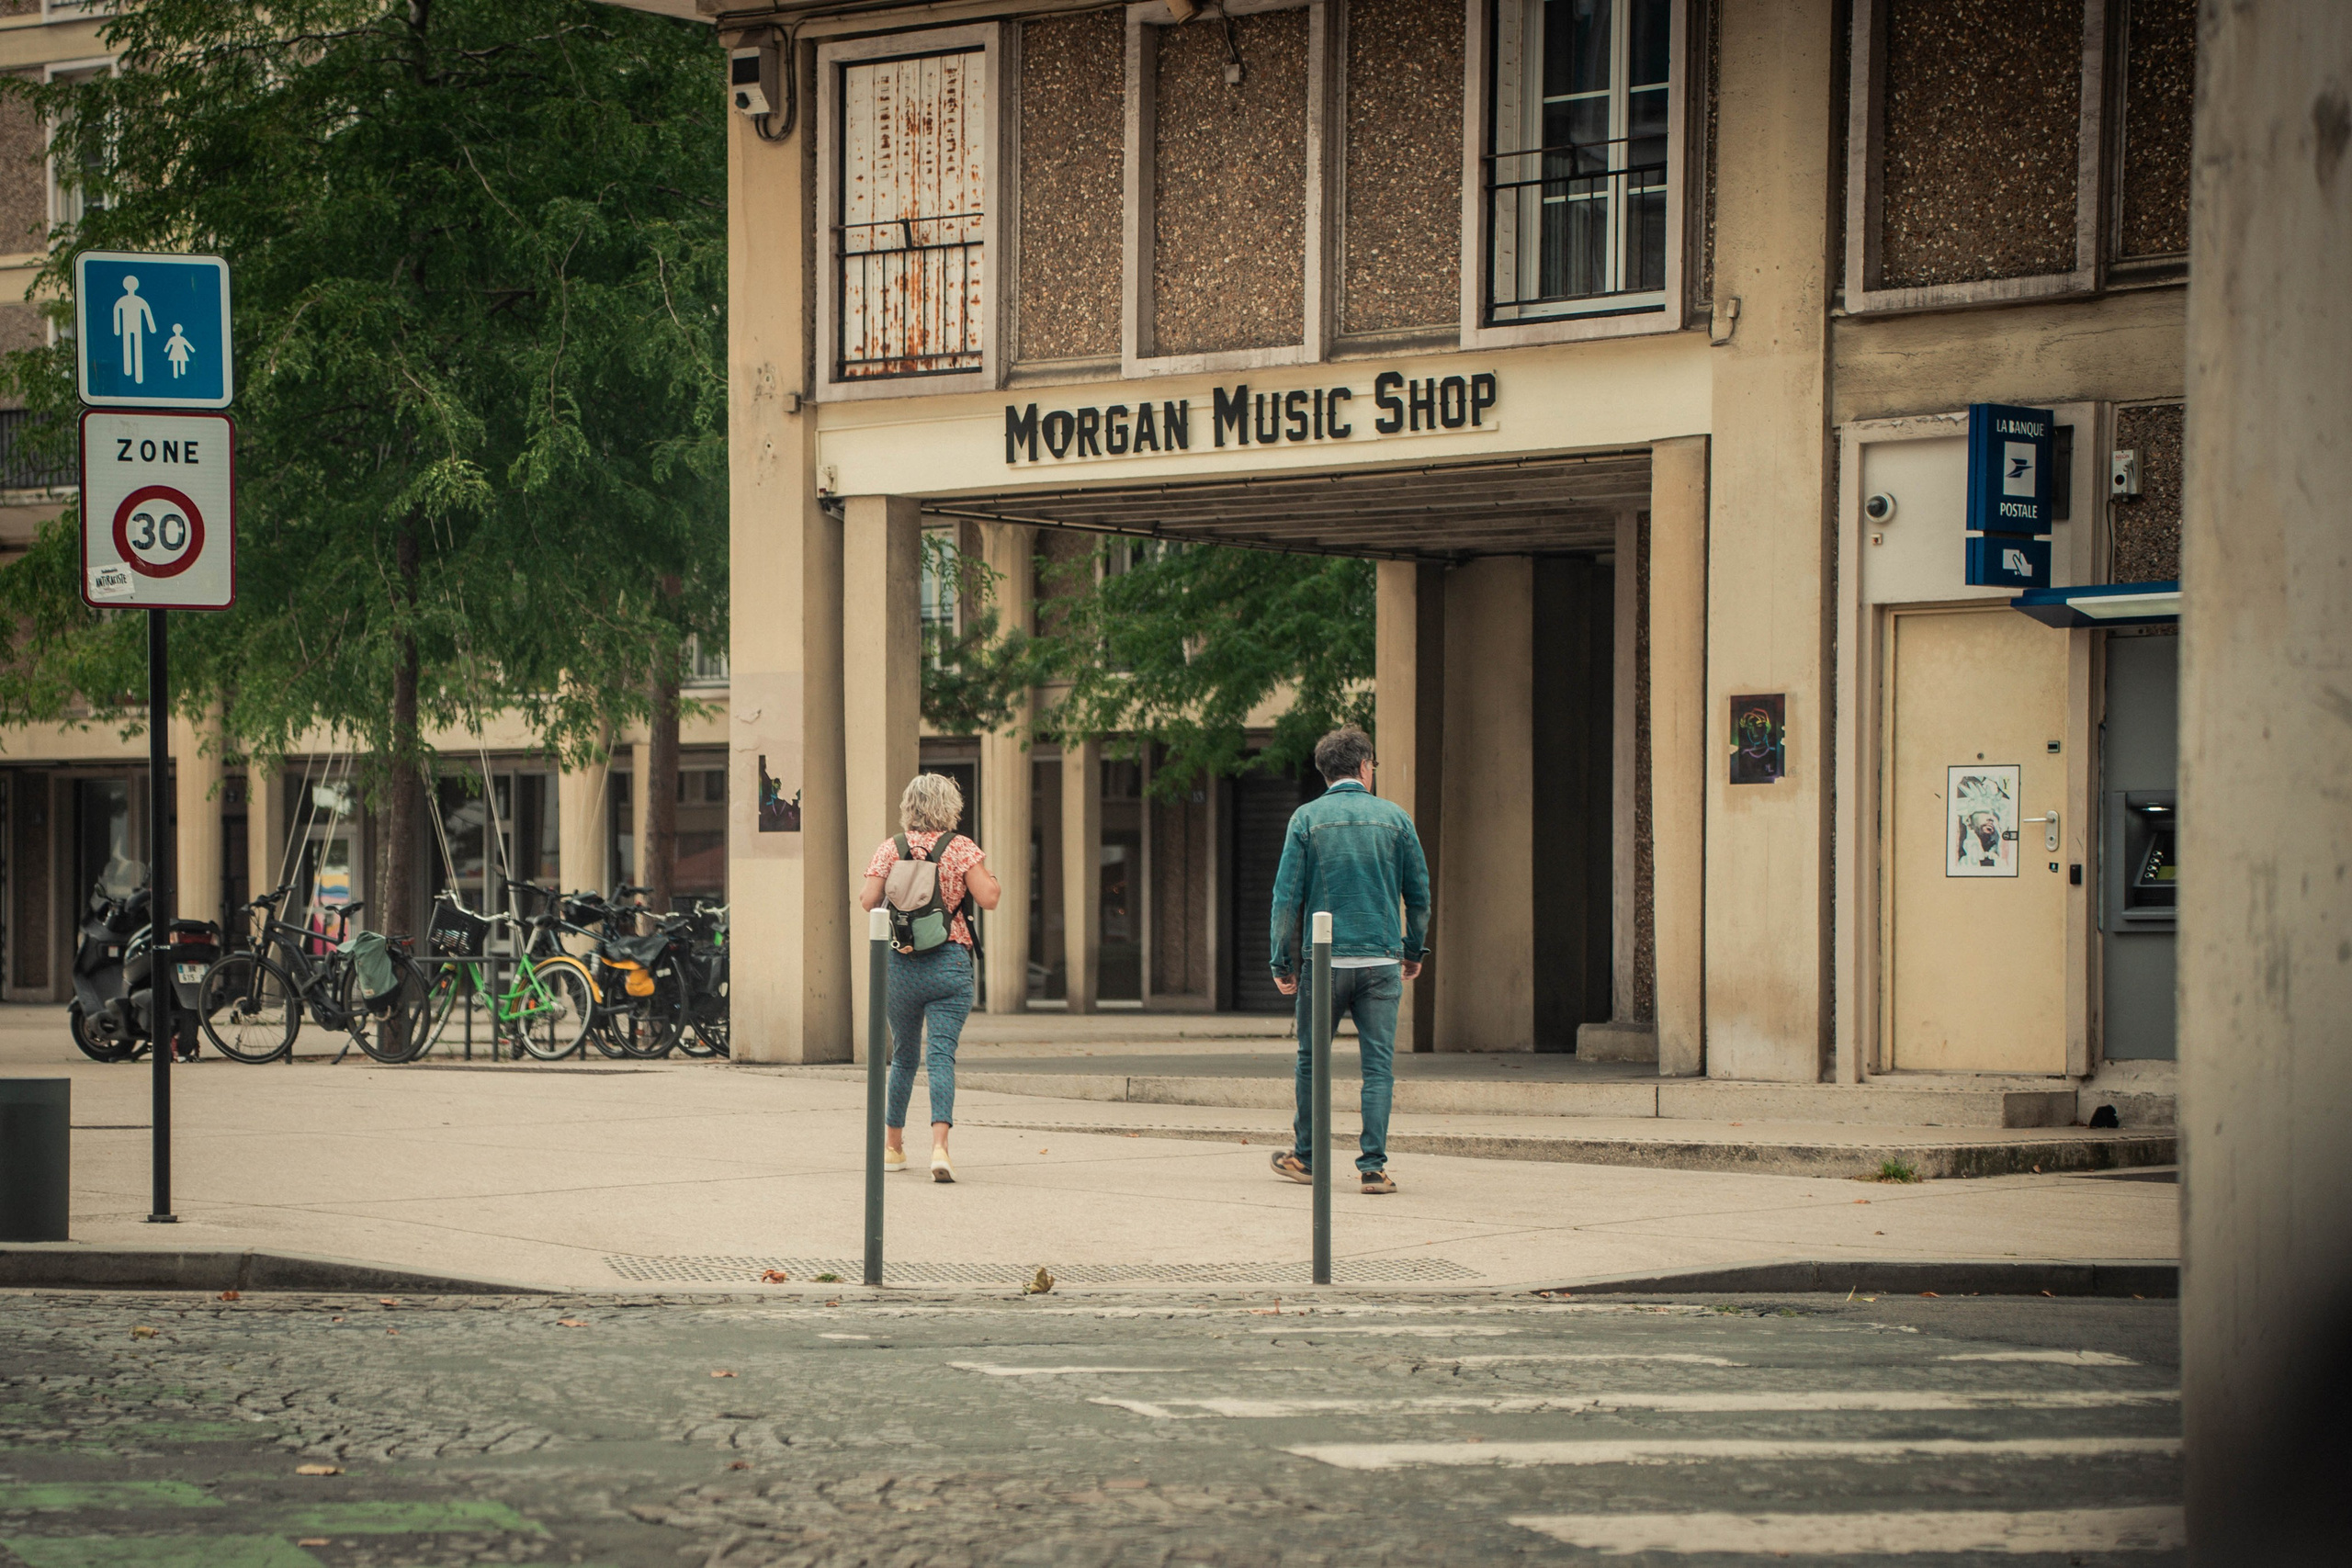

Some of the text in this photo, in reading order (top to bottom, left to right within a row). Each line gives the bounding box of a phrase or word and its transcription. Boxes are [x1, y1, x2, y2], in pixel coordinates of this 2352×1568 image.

[1996, 419, 2045, 437] LA BANQUE
[117, 438, 199, 464] ZONE
[2000, 502, 2039, 519] POSTALE
[131, 512, 186, 551] 30
